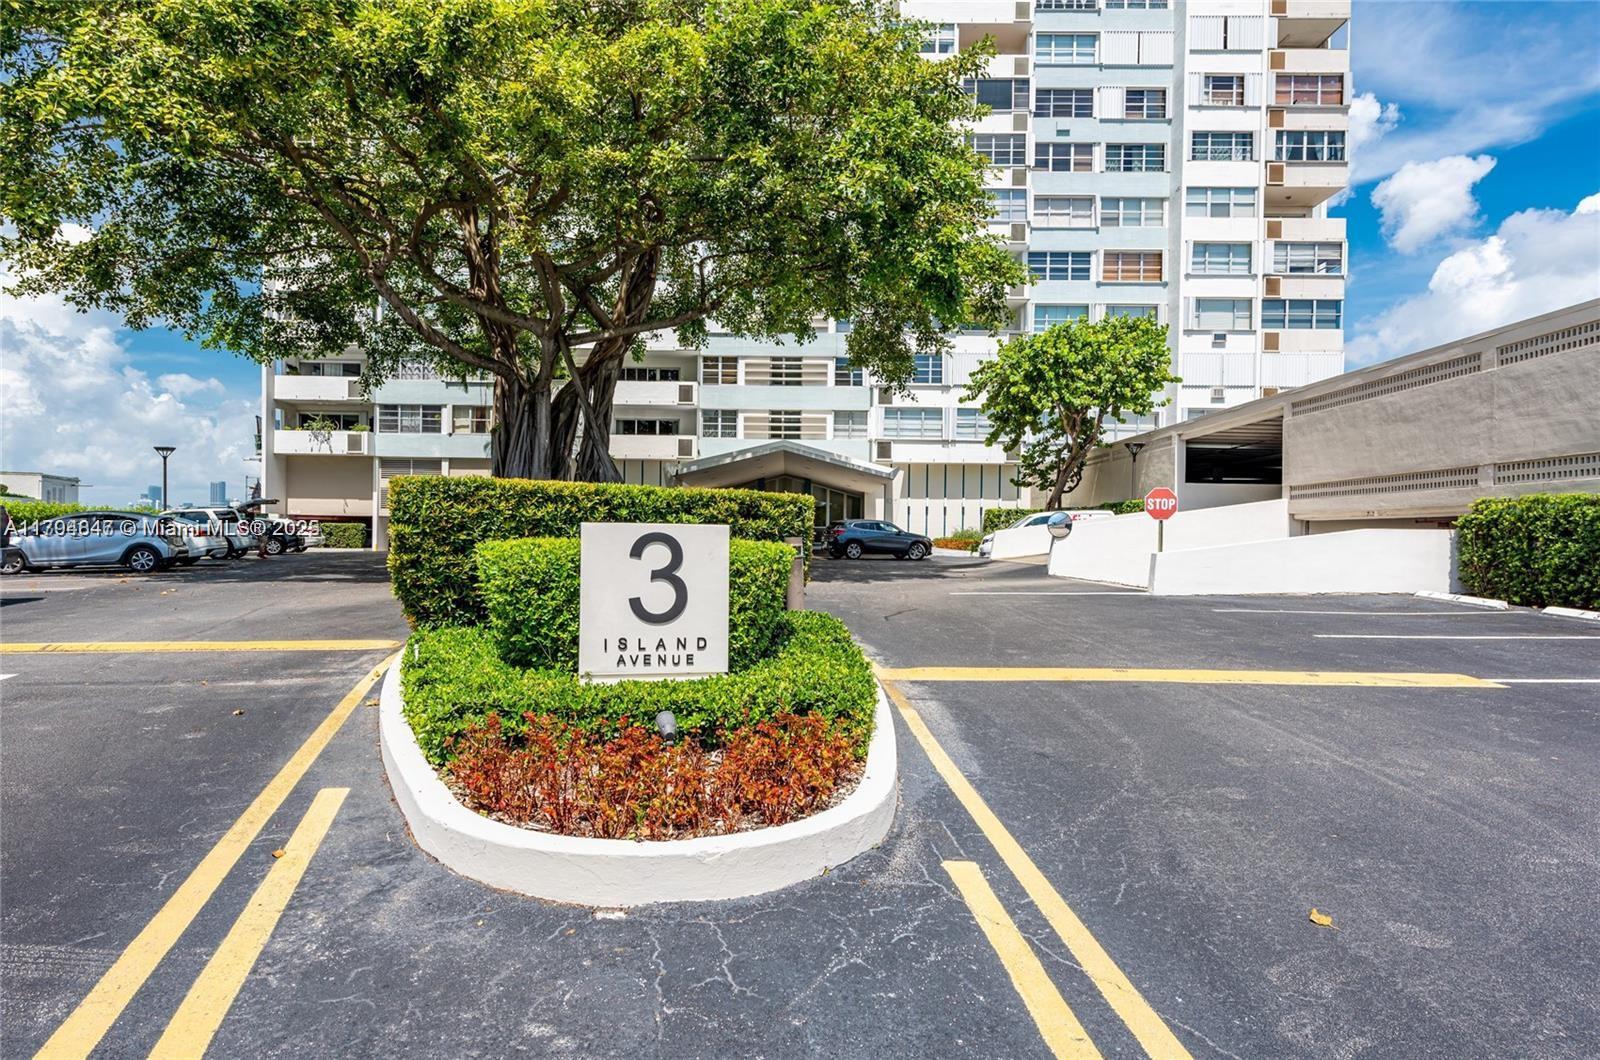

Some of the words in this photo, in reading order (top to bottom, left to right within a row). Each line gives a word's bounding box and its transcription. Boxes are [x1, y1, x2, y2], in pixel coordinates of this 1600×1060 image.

[1147, 498, 1176, 510] STOP
[628, 531, 688, 626] 3
[604, 637, 708, 652] ISLAND
[617, 654, 695, 667] AVENUE
